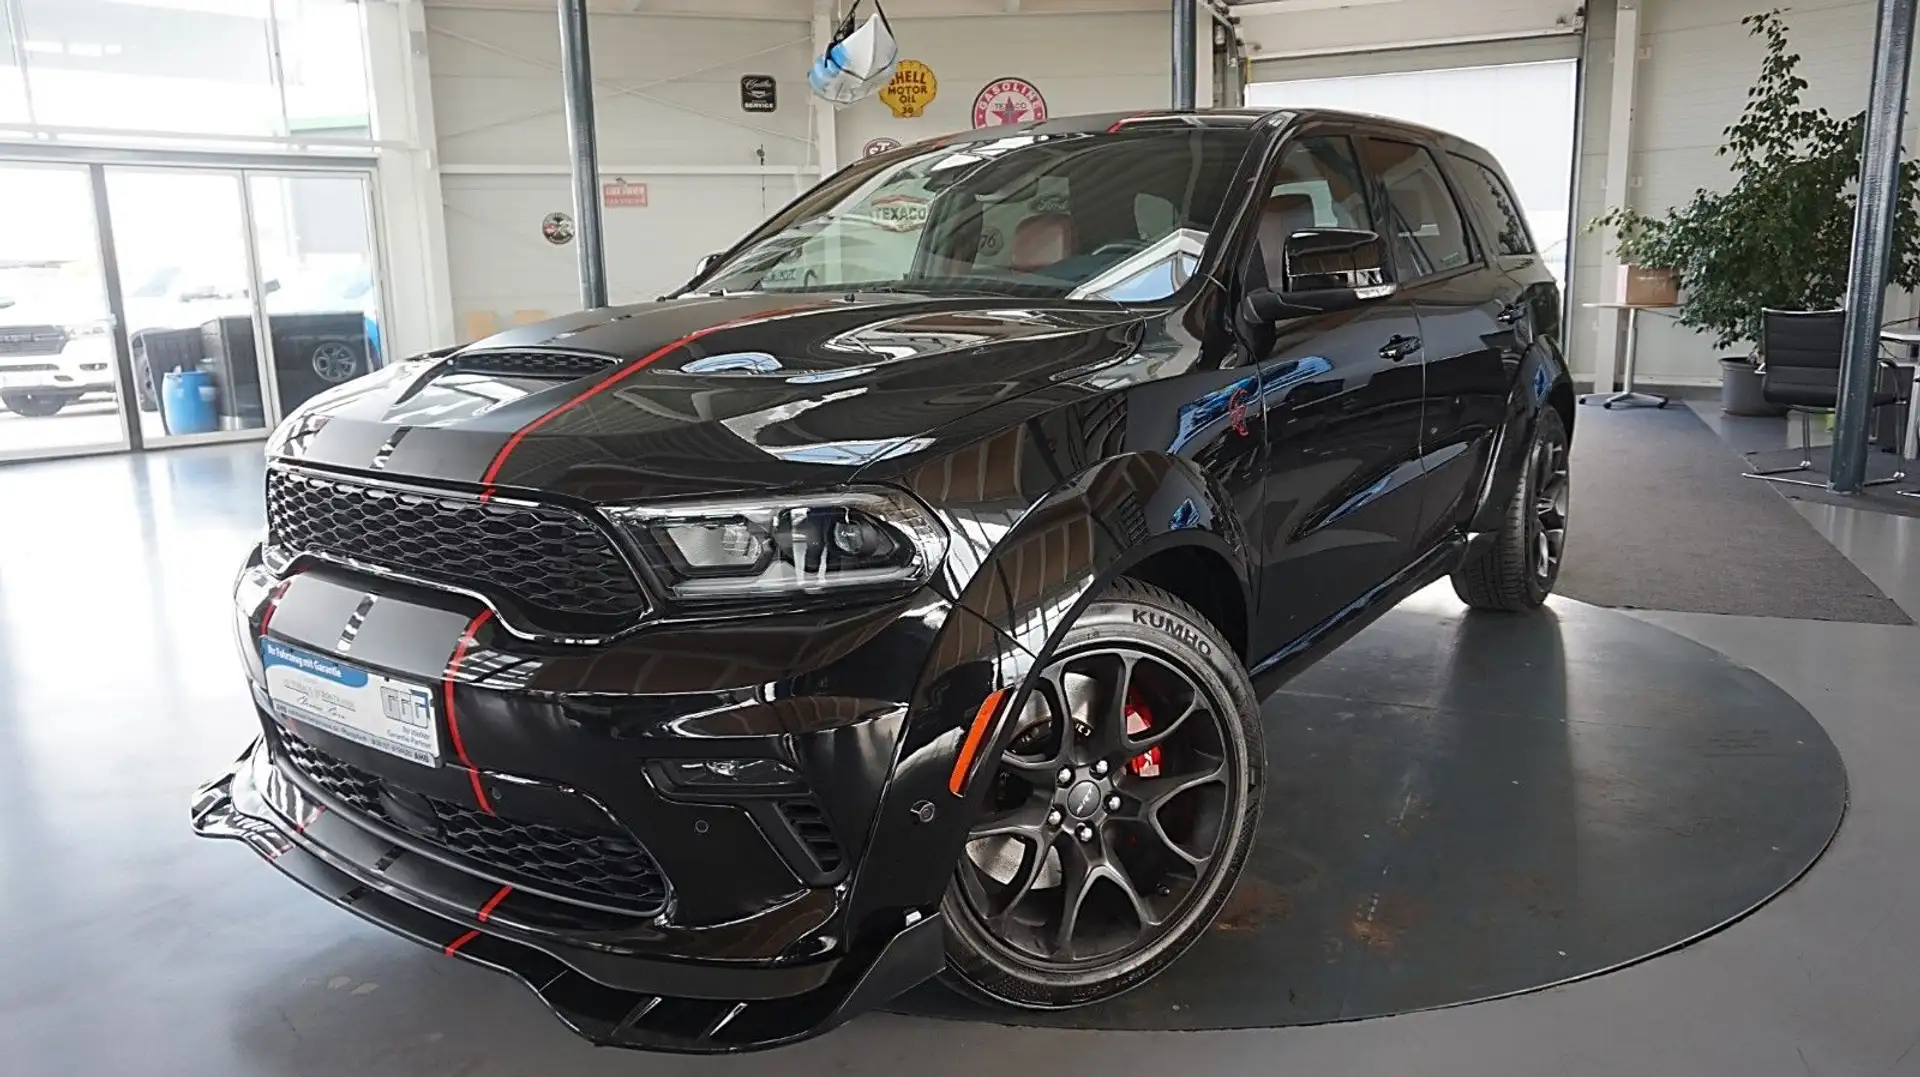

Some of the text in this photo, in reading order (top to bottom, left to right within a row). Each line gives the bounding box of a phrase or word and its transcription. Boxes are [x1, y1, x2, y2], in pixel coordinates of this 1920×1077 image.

[888, 86, 928, 95] MOTOR
[980, 82, 1042, 110] GASOLINE
[899, 95, 917, 104] OIL
[902, 106, 914, 114] 30
[874, 207, 927, 221] TEXACO
[980, 232, 996, 249] 76
[1132, 608, 1211, 656] KUMHO
